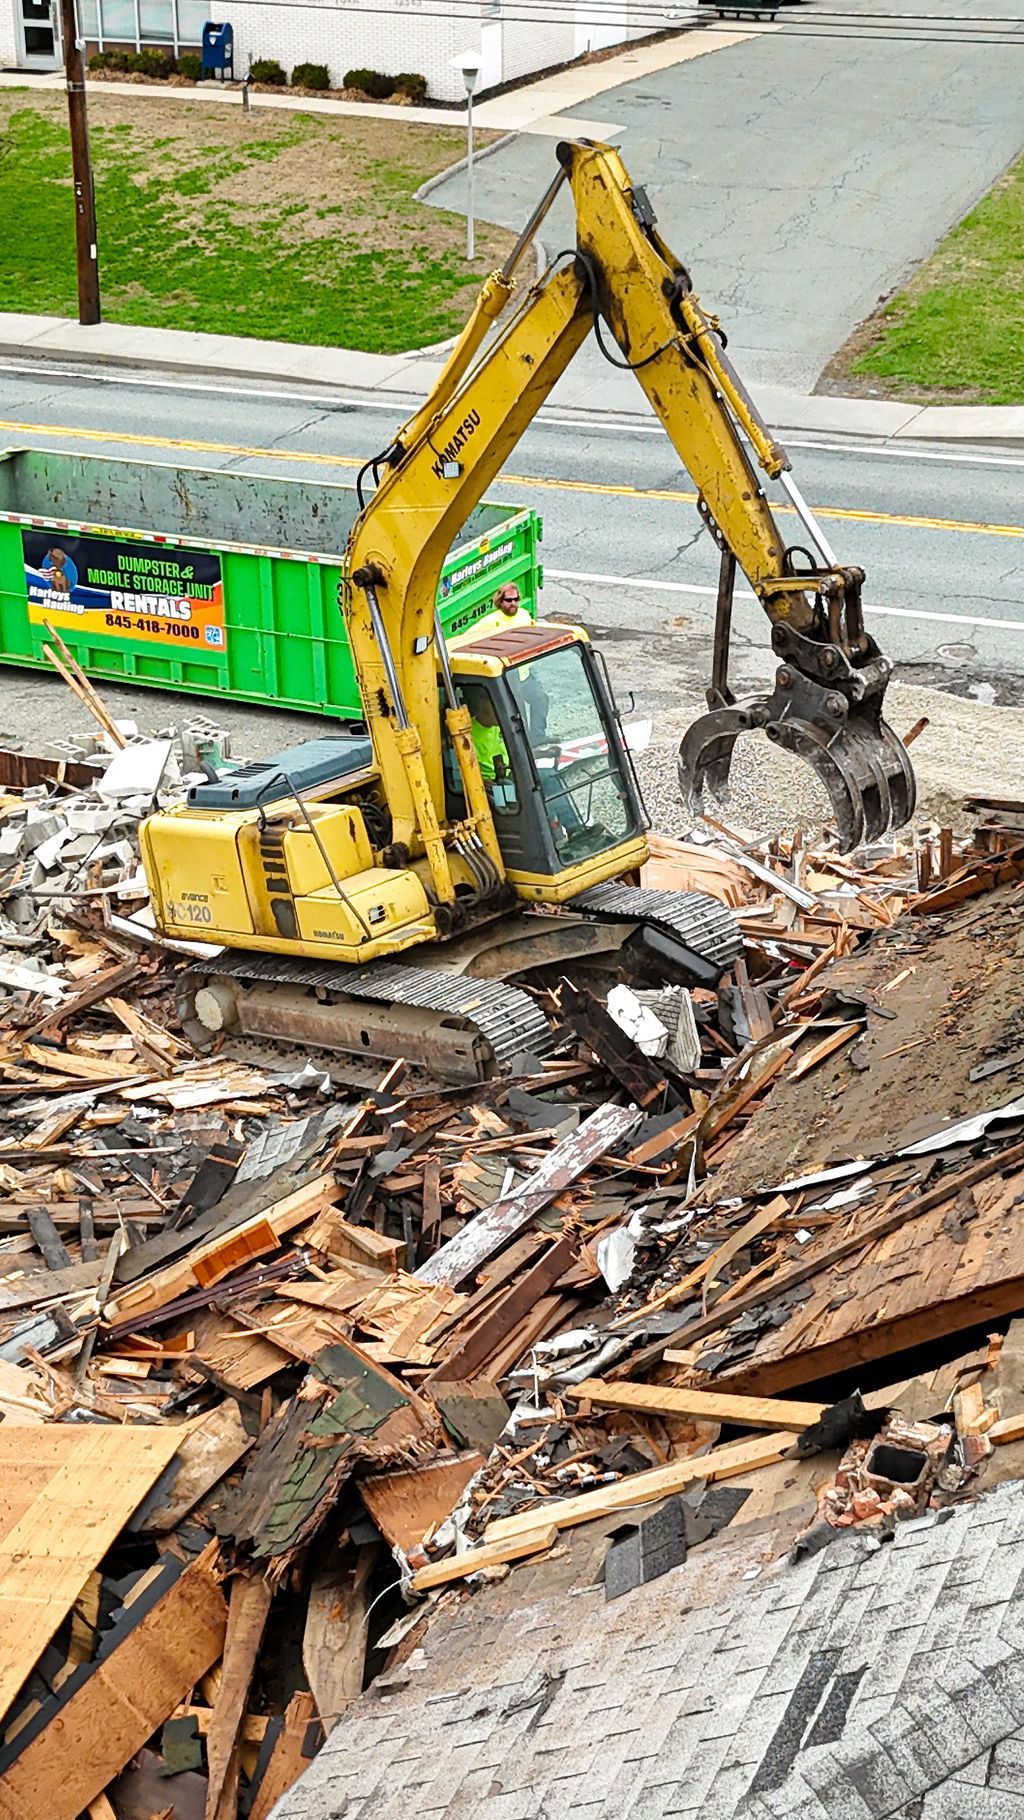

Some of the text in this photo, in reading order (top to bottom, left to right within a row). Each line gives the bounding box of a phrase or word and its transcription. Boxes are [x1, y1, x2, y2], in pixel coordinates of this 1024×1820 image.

[117, 554, 194, 579] DUMPSTER &
[451, 560, 482, 586] Harleys
[29, 585, 70, 601] Harleys
[87, 568, 214, 600] MOBILE STORAGE UNIT
[43, 598, 85, 615] Hauling
[110, 590, 192, 621] RENTALS
[451, 598, 494, 633] 845-418-7
[105, 614, 200, 639] 845-418-7000
